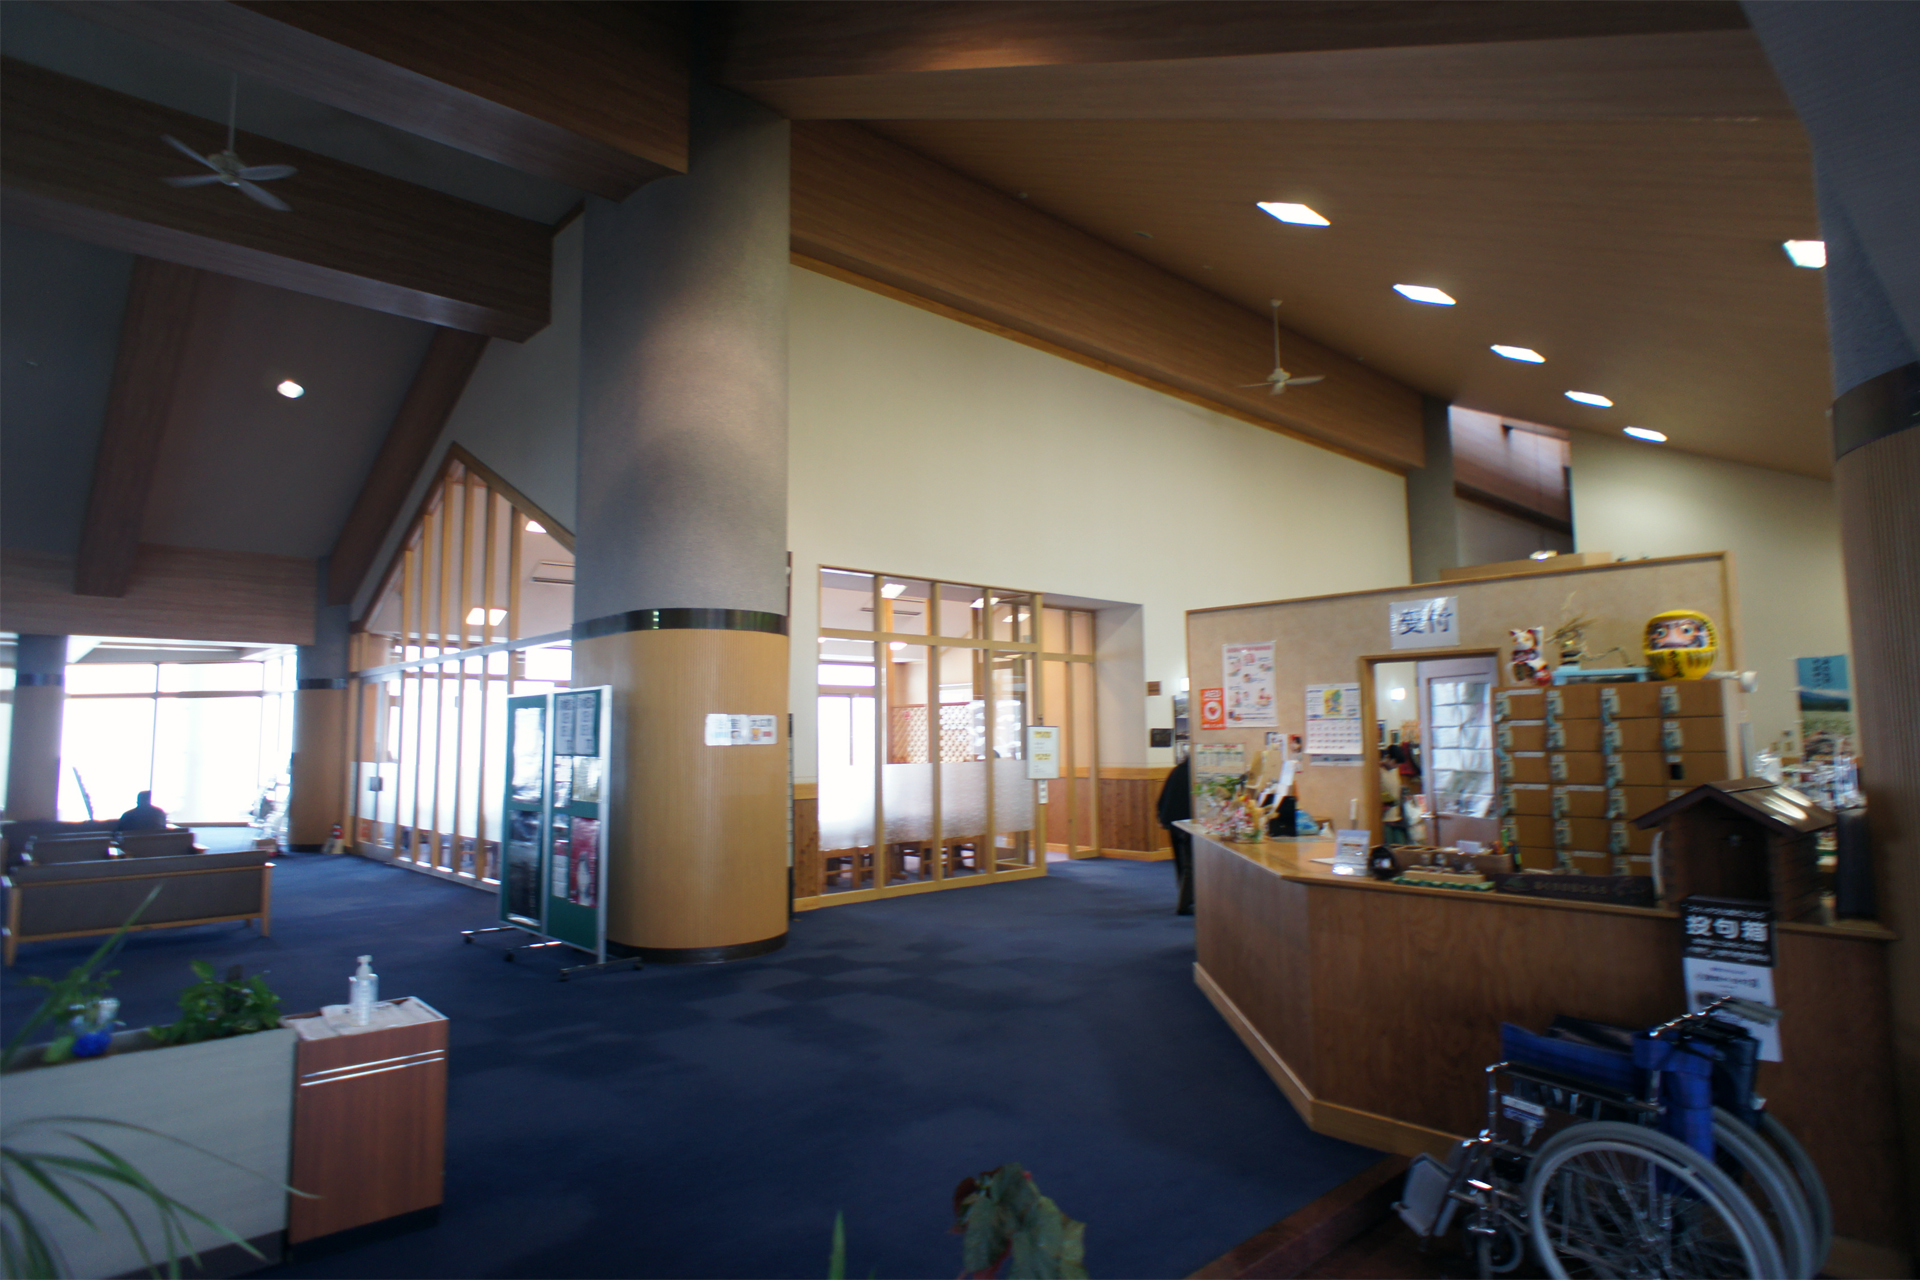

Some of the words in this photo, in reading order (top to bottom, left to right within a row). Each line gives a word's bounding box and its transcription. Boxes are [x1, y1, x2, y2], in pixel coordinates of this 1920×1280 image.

[1398, 608, 1454, 635] 受付
[1204, 690, 1222, 698] AED
[1685, 914, 1769, 942] 投句箱
